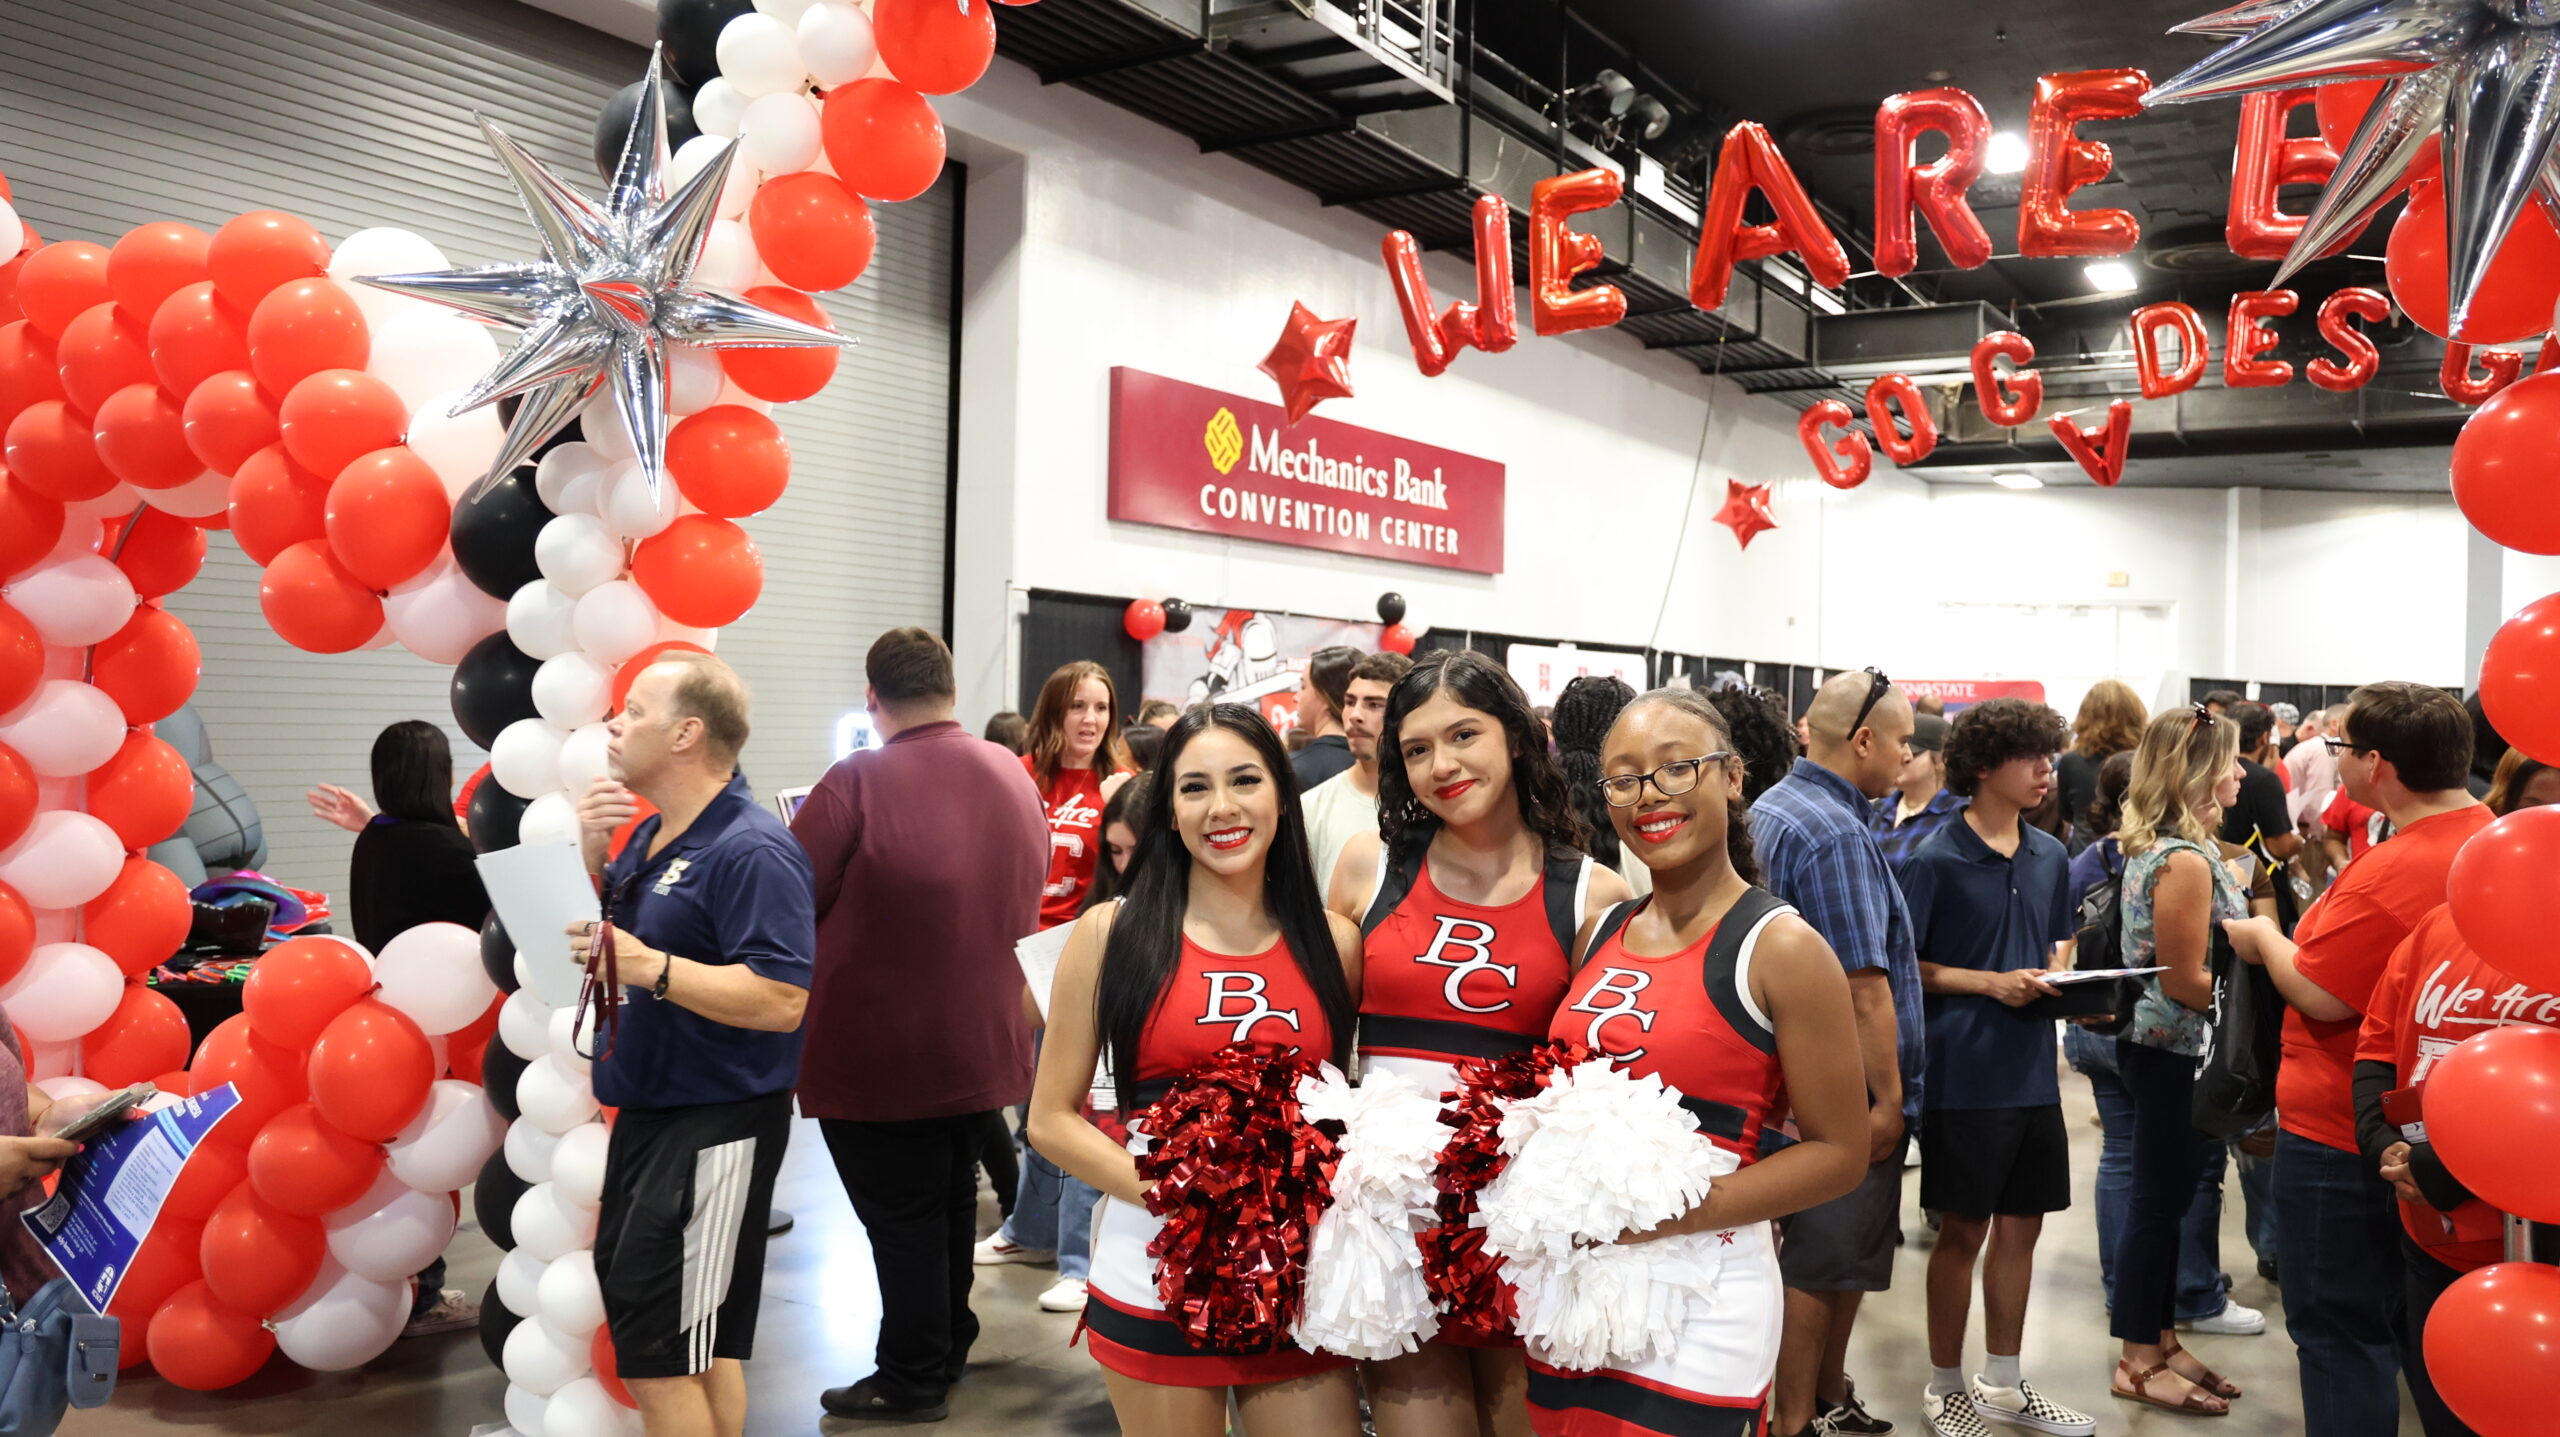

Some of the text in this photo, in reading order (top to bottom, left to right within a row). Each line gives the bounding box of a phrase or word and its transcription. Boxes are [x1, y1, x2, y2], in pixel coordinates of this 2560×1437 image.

[1382, 166, 1628, 378] WE
[1690, 67, 2153, 311] ARE
[1248, 423, 1449, 511] Mechanics Bank
[1798, 371, 1938, 490] GO
[1199, 483, 1459, 556] CONVENTION CENTER
[1414, 914, 1518, 1014] BC
[2414, 960, 2485, 1030] We
